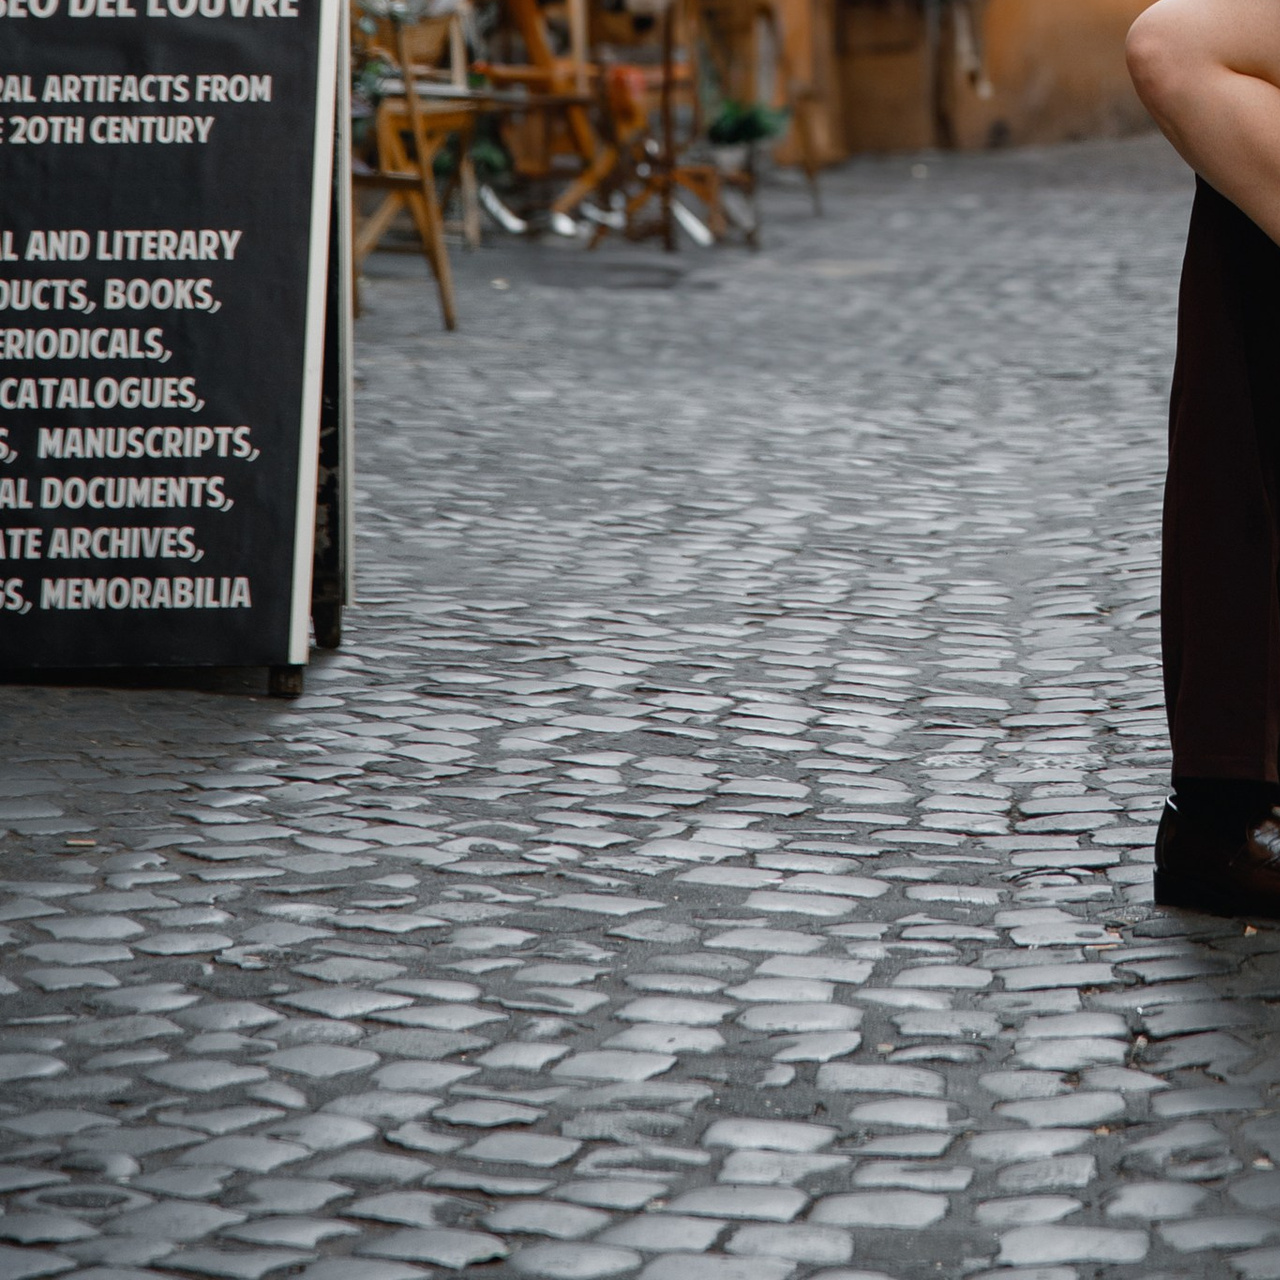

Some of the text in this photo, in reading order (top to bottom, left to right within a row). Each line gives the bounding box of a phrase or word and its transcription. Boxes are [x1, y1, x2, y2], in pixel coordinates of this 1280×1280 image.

[0, 74, 272, 103] AL ARTIFACTS FROM
[8, 115, 84, 144] 20TH
[89, 115, 215, 144] CENTURY
[0, 229, 242, 261] L AND LITERARY
[104, 278, 222, 314] BOOKS,
[0, 377, 205, 413] CATALOGUES,
[37, 425, 260, 462] MANUSCRIPTS,
[40, 475, 234, 512] DOCUMENTS,
[0, 526, 205, 563] TE ARCHIVES,
[0, 576, 252, 615] S, MEMORABILIA
